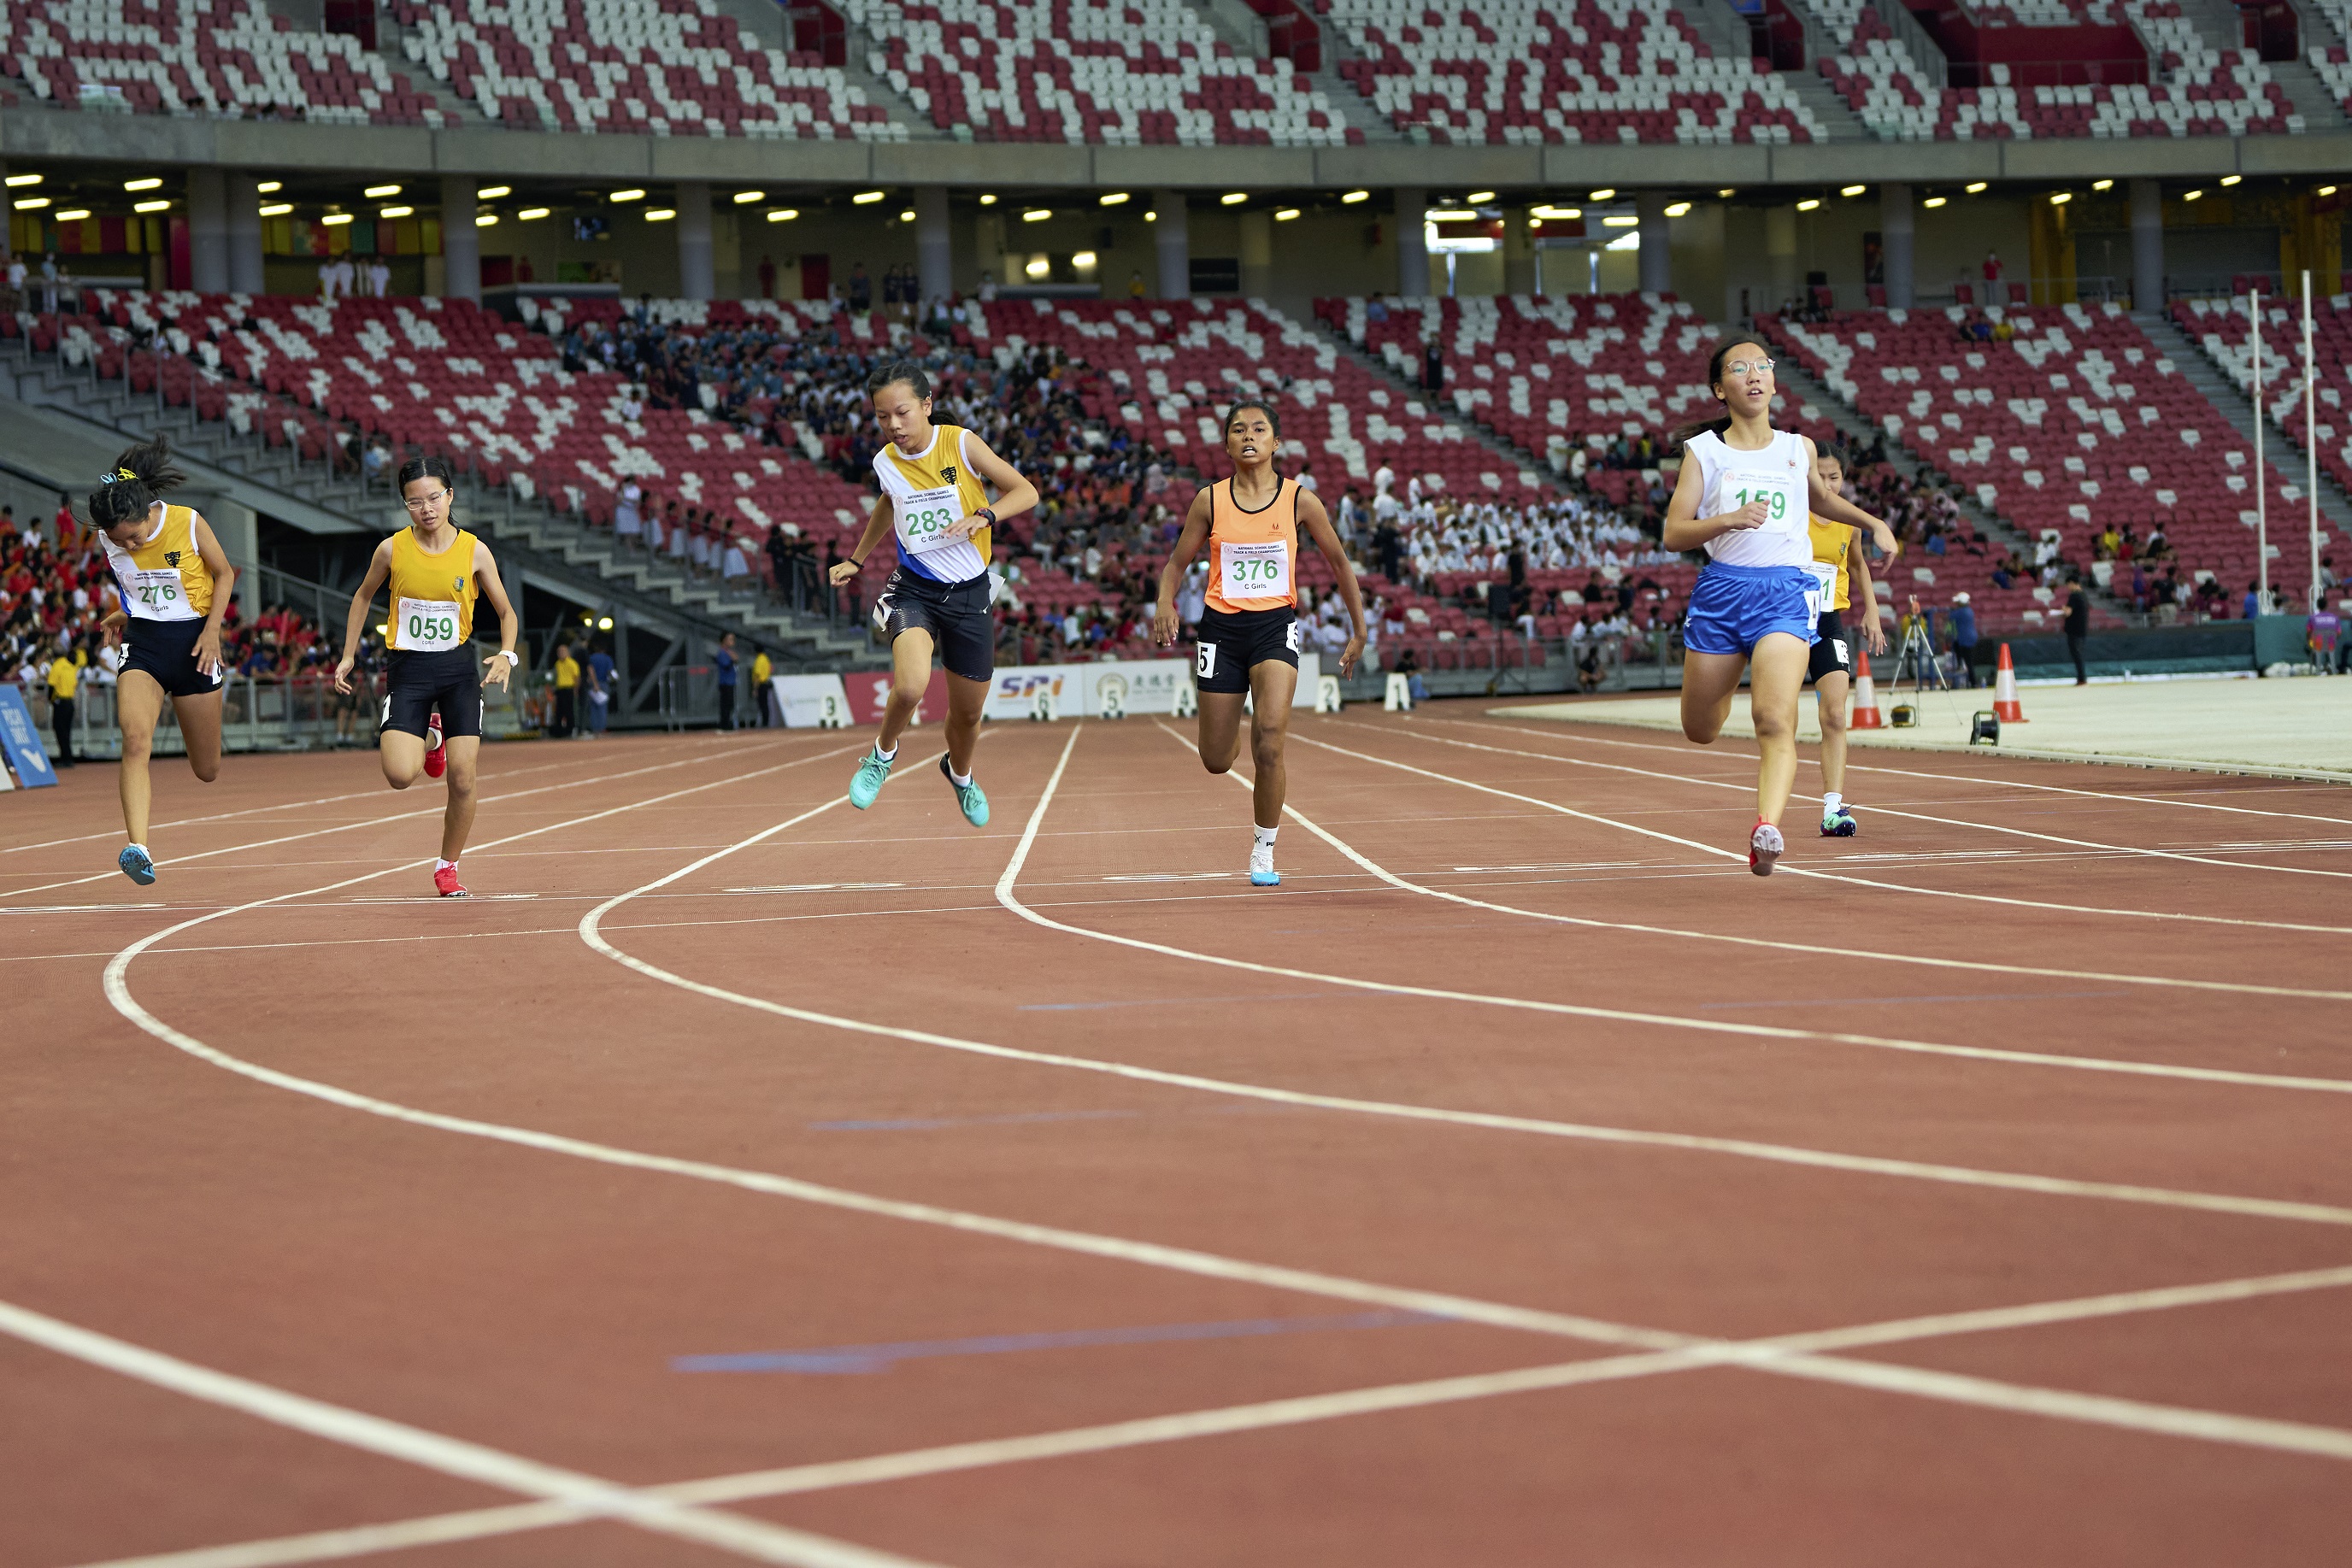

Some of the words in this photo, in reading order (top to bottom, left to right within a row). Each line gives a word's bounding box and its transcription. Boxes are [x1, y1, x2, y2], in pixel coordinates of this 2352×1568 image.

[1735, 488, 1785, 520] 159
[905, 508, 953, 536] 283
[928, 533, 944, 542] Girls
[1232, 560, 1278, 581] 376
[138, 584, 177, 604] 276
[409, 614, 453, 641] 059
[1199, 647, 1208, 672] 5
[1038, 691, 1050, 712] 6
[1108, 690, 1118, 710] 5
[1179, 688, 1190, 707] 4
[1324, 683, 1333, 705] 2
[826, 696, 836, 716] 3
